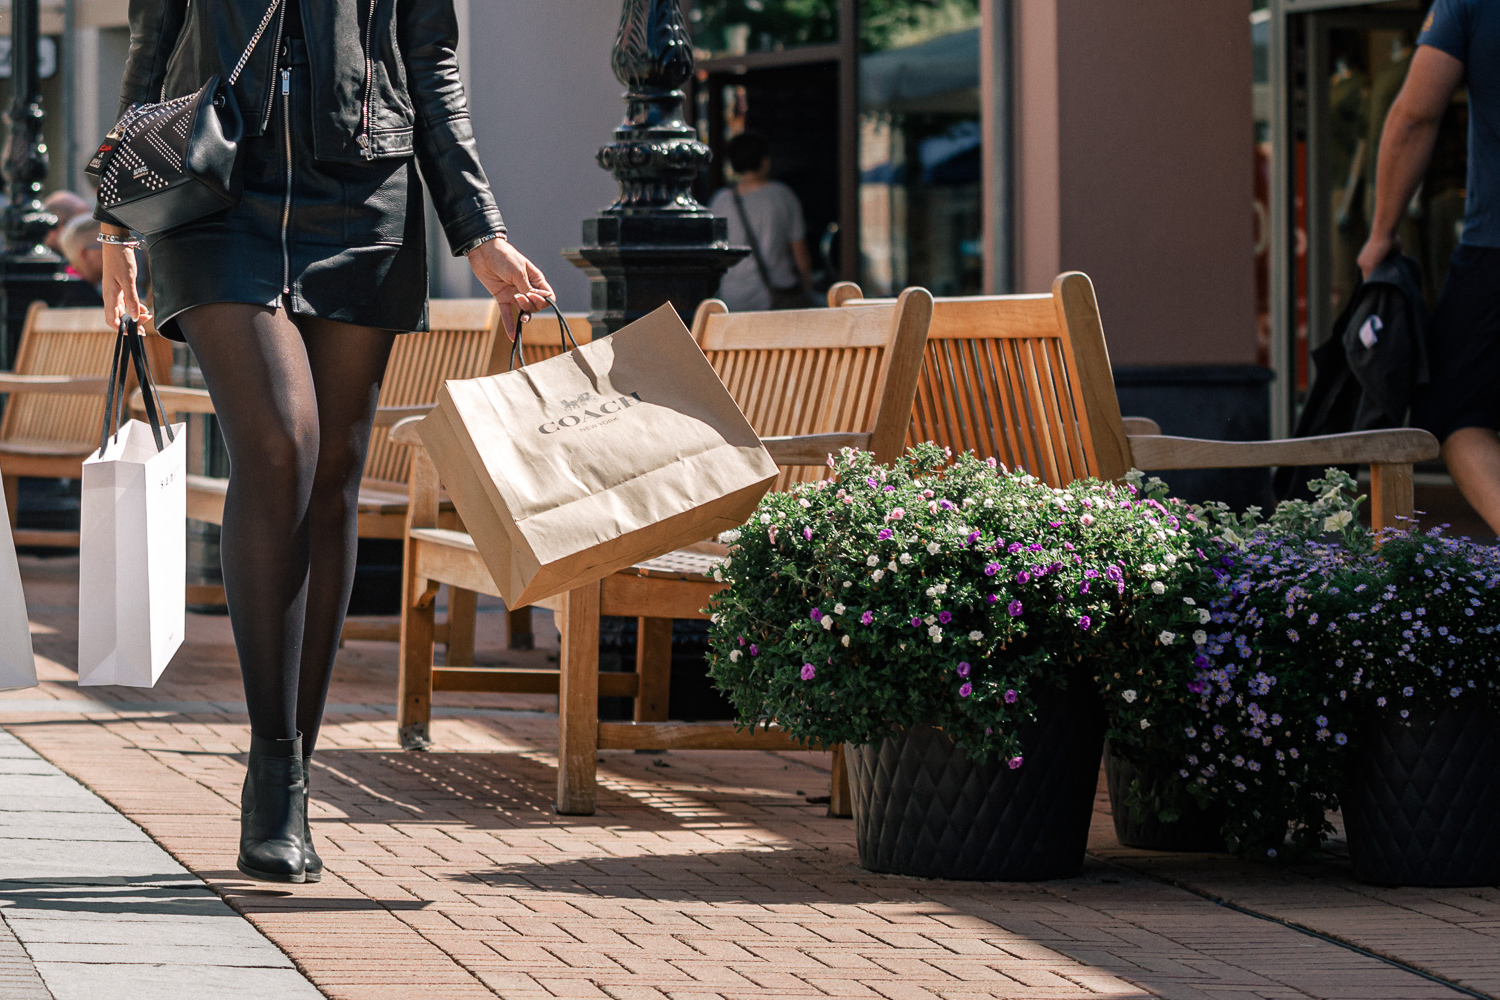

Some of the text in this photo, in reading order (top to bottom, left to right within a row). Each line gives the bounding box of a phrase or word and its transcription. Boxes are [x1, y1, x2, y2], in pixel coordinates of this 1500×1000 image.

[538, 391, 642, 435] COACH
[580, 417, 620, 433] NEW YORK
